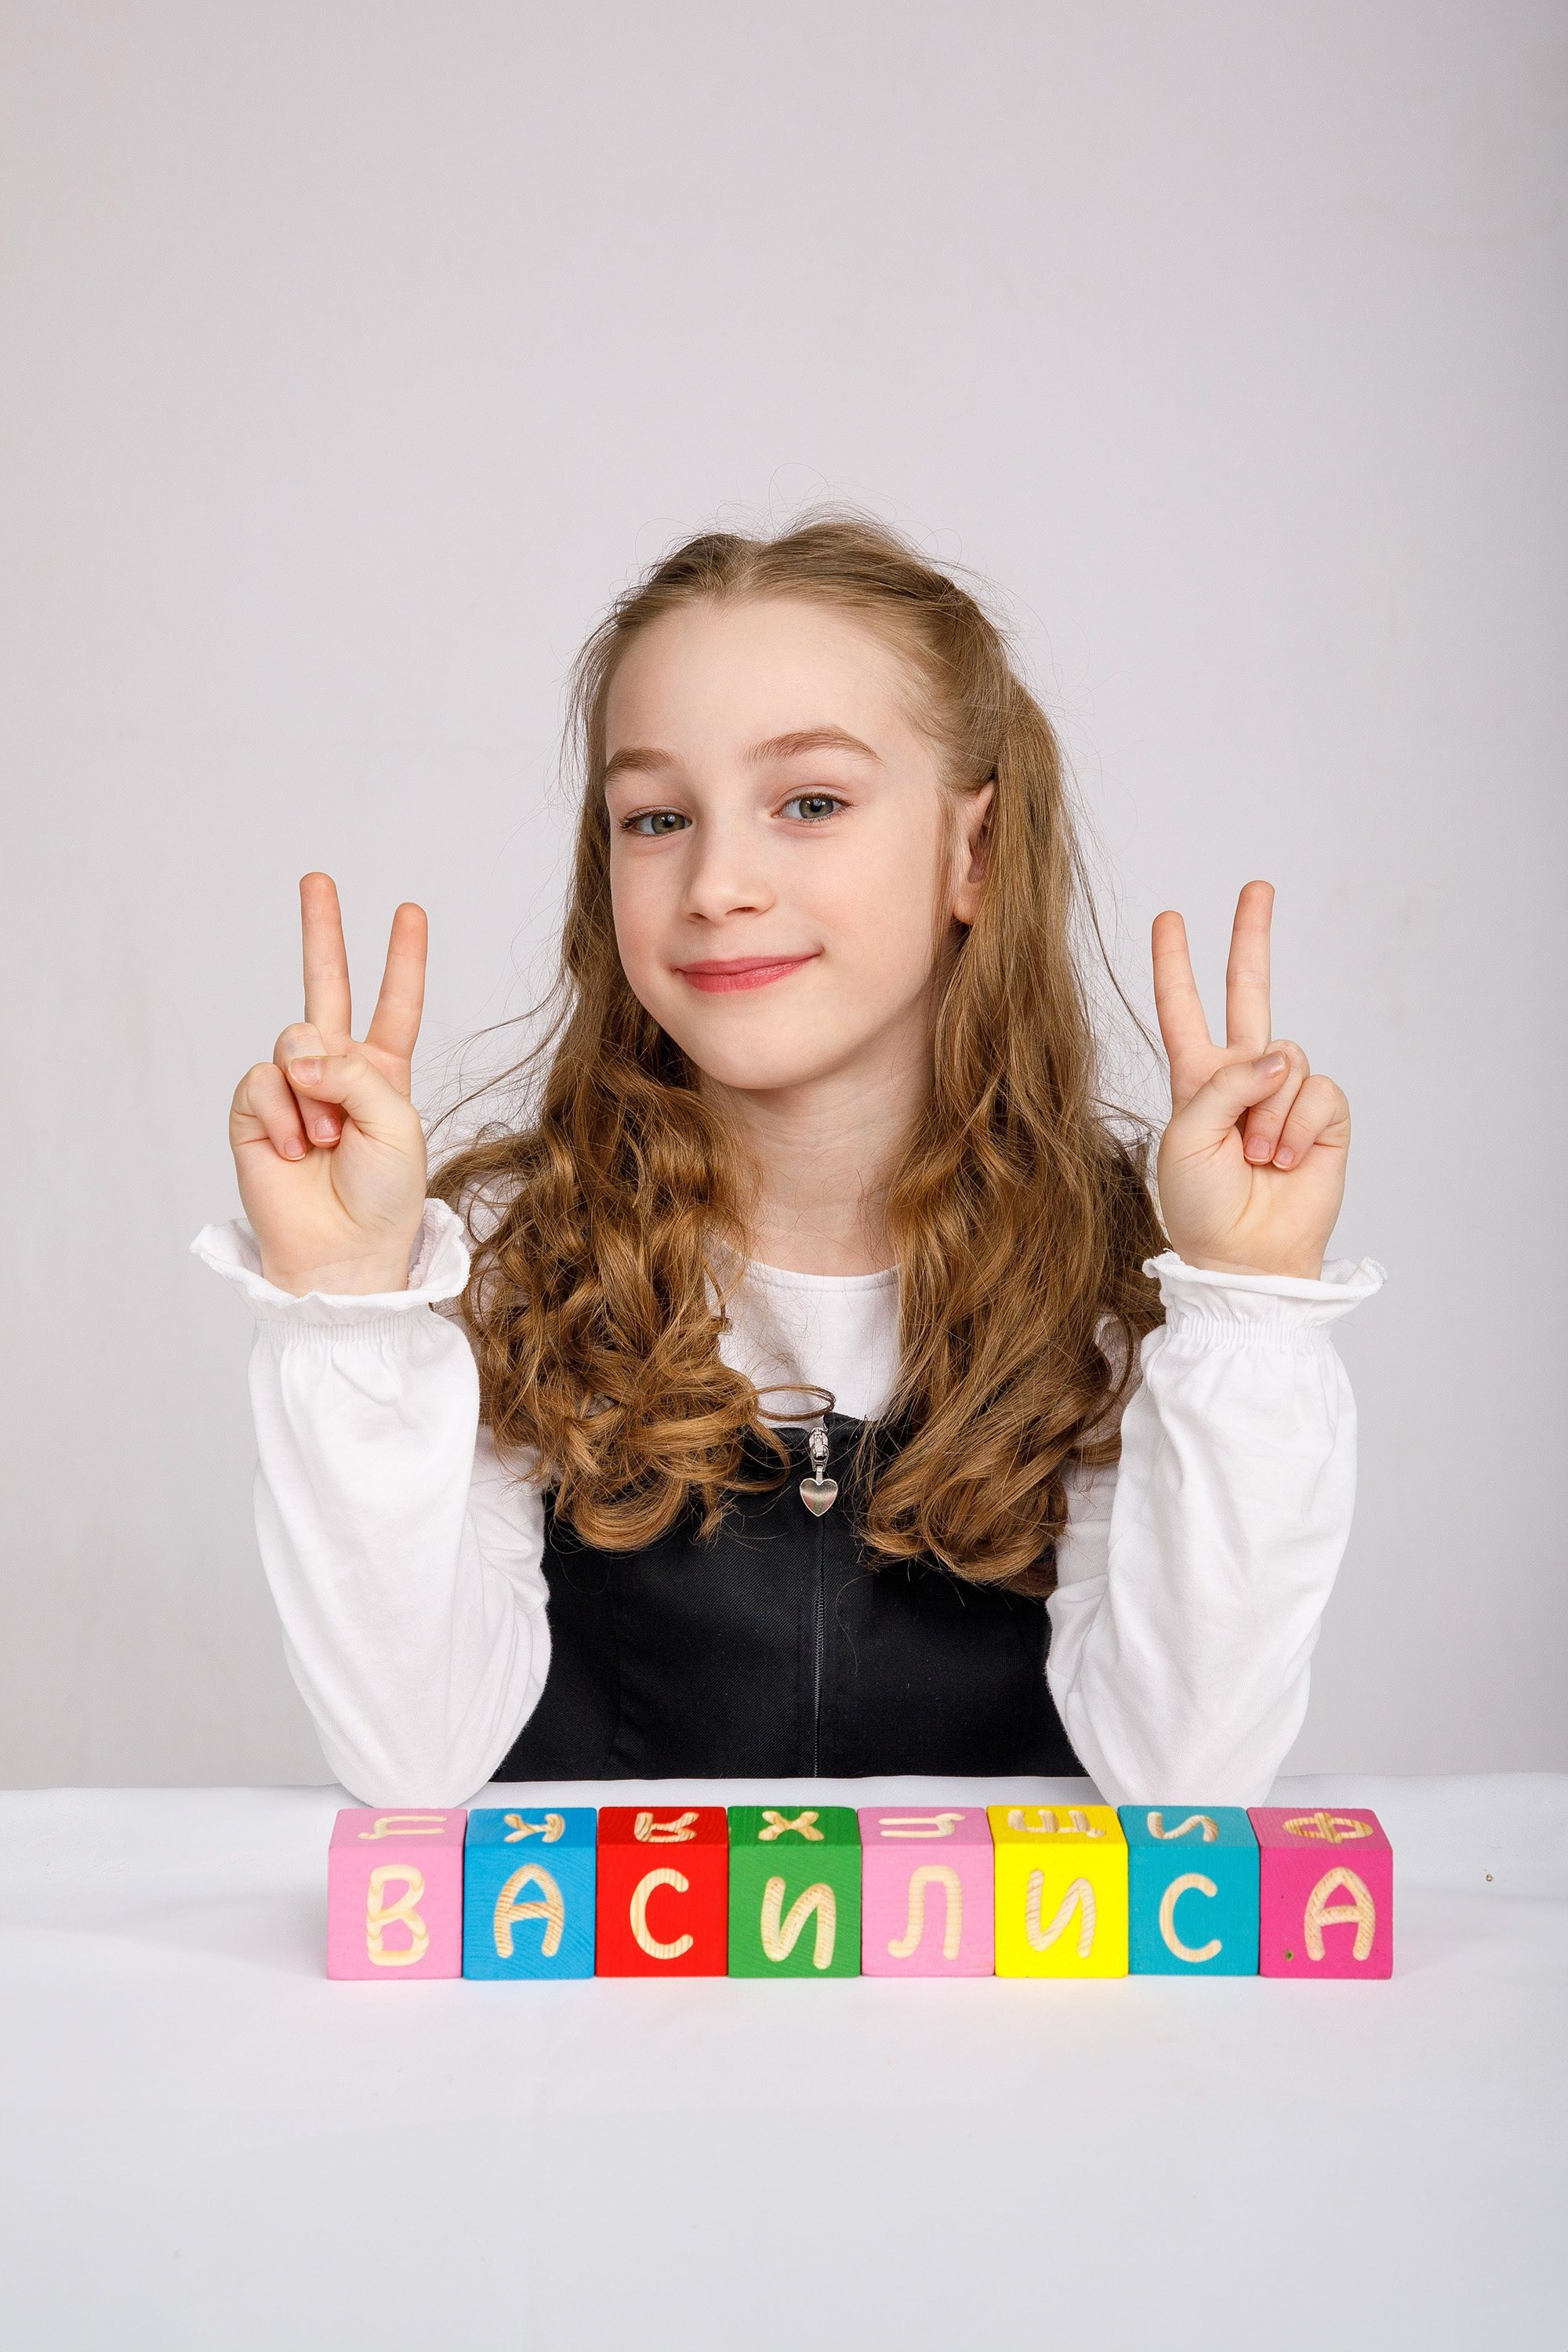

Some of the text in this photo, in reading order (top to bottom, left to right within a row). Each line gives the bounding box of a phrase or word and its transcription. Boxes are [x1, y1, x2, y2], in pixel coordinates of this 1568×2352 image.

[503, 1813, 566, 1843] К
[1007, 1809, 1106, 1838] Щ
[1283, 1813, 1374, 1843] Ф
[365, 1864, 1376, 1970] ВАСИЛИСА
